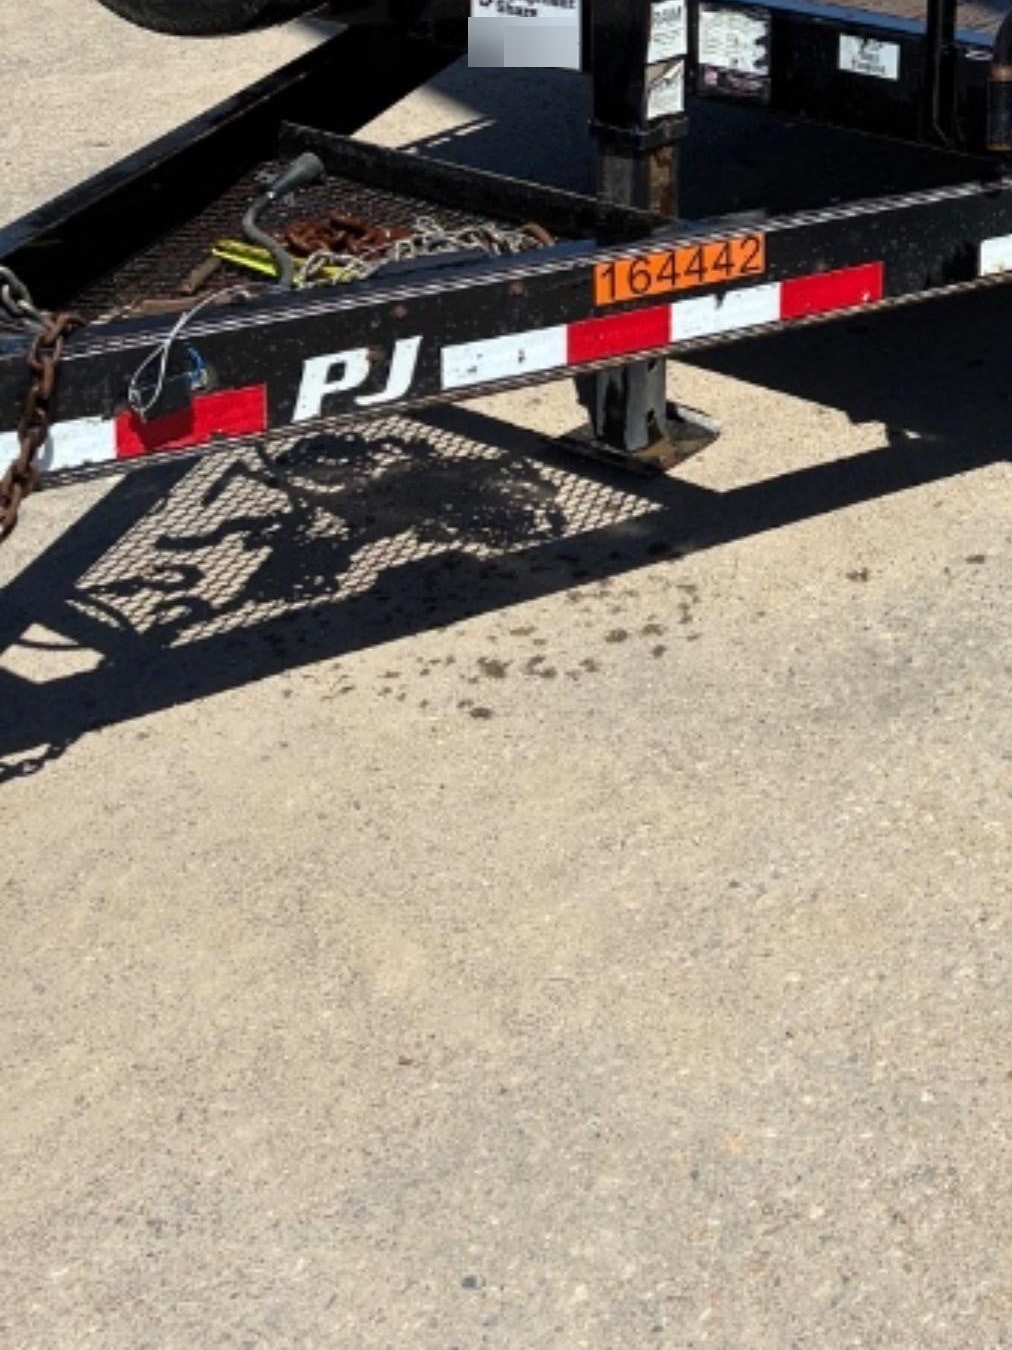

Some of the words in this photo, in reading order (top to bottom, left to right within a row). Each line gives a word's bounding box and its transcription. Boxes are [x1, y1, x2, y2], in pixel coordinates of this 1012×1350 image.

[495, 0, 538, 17] Share
[601, 233, 762, 302] 164442
[291, 335, 423, 422] PJ
